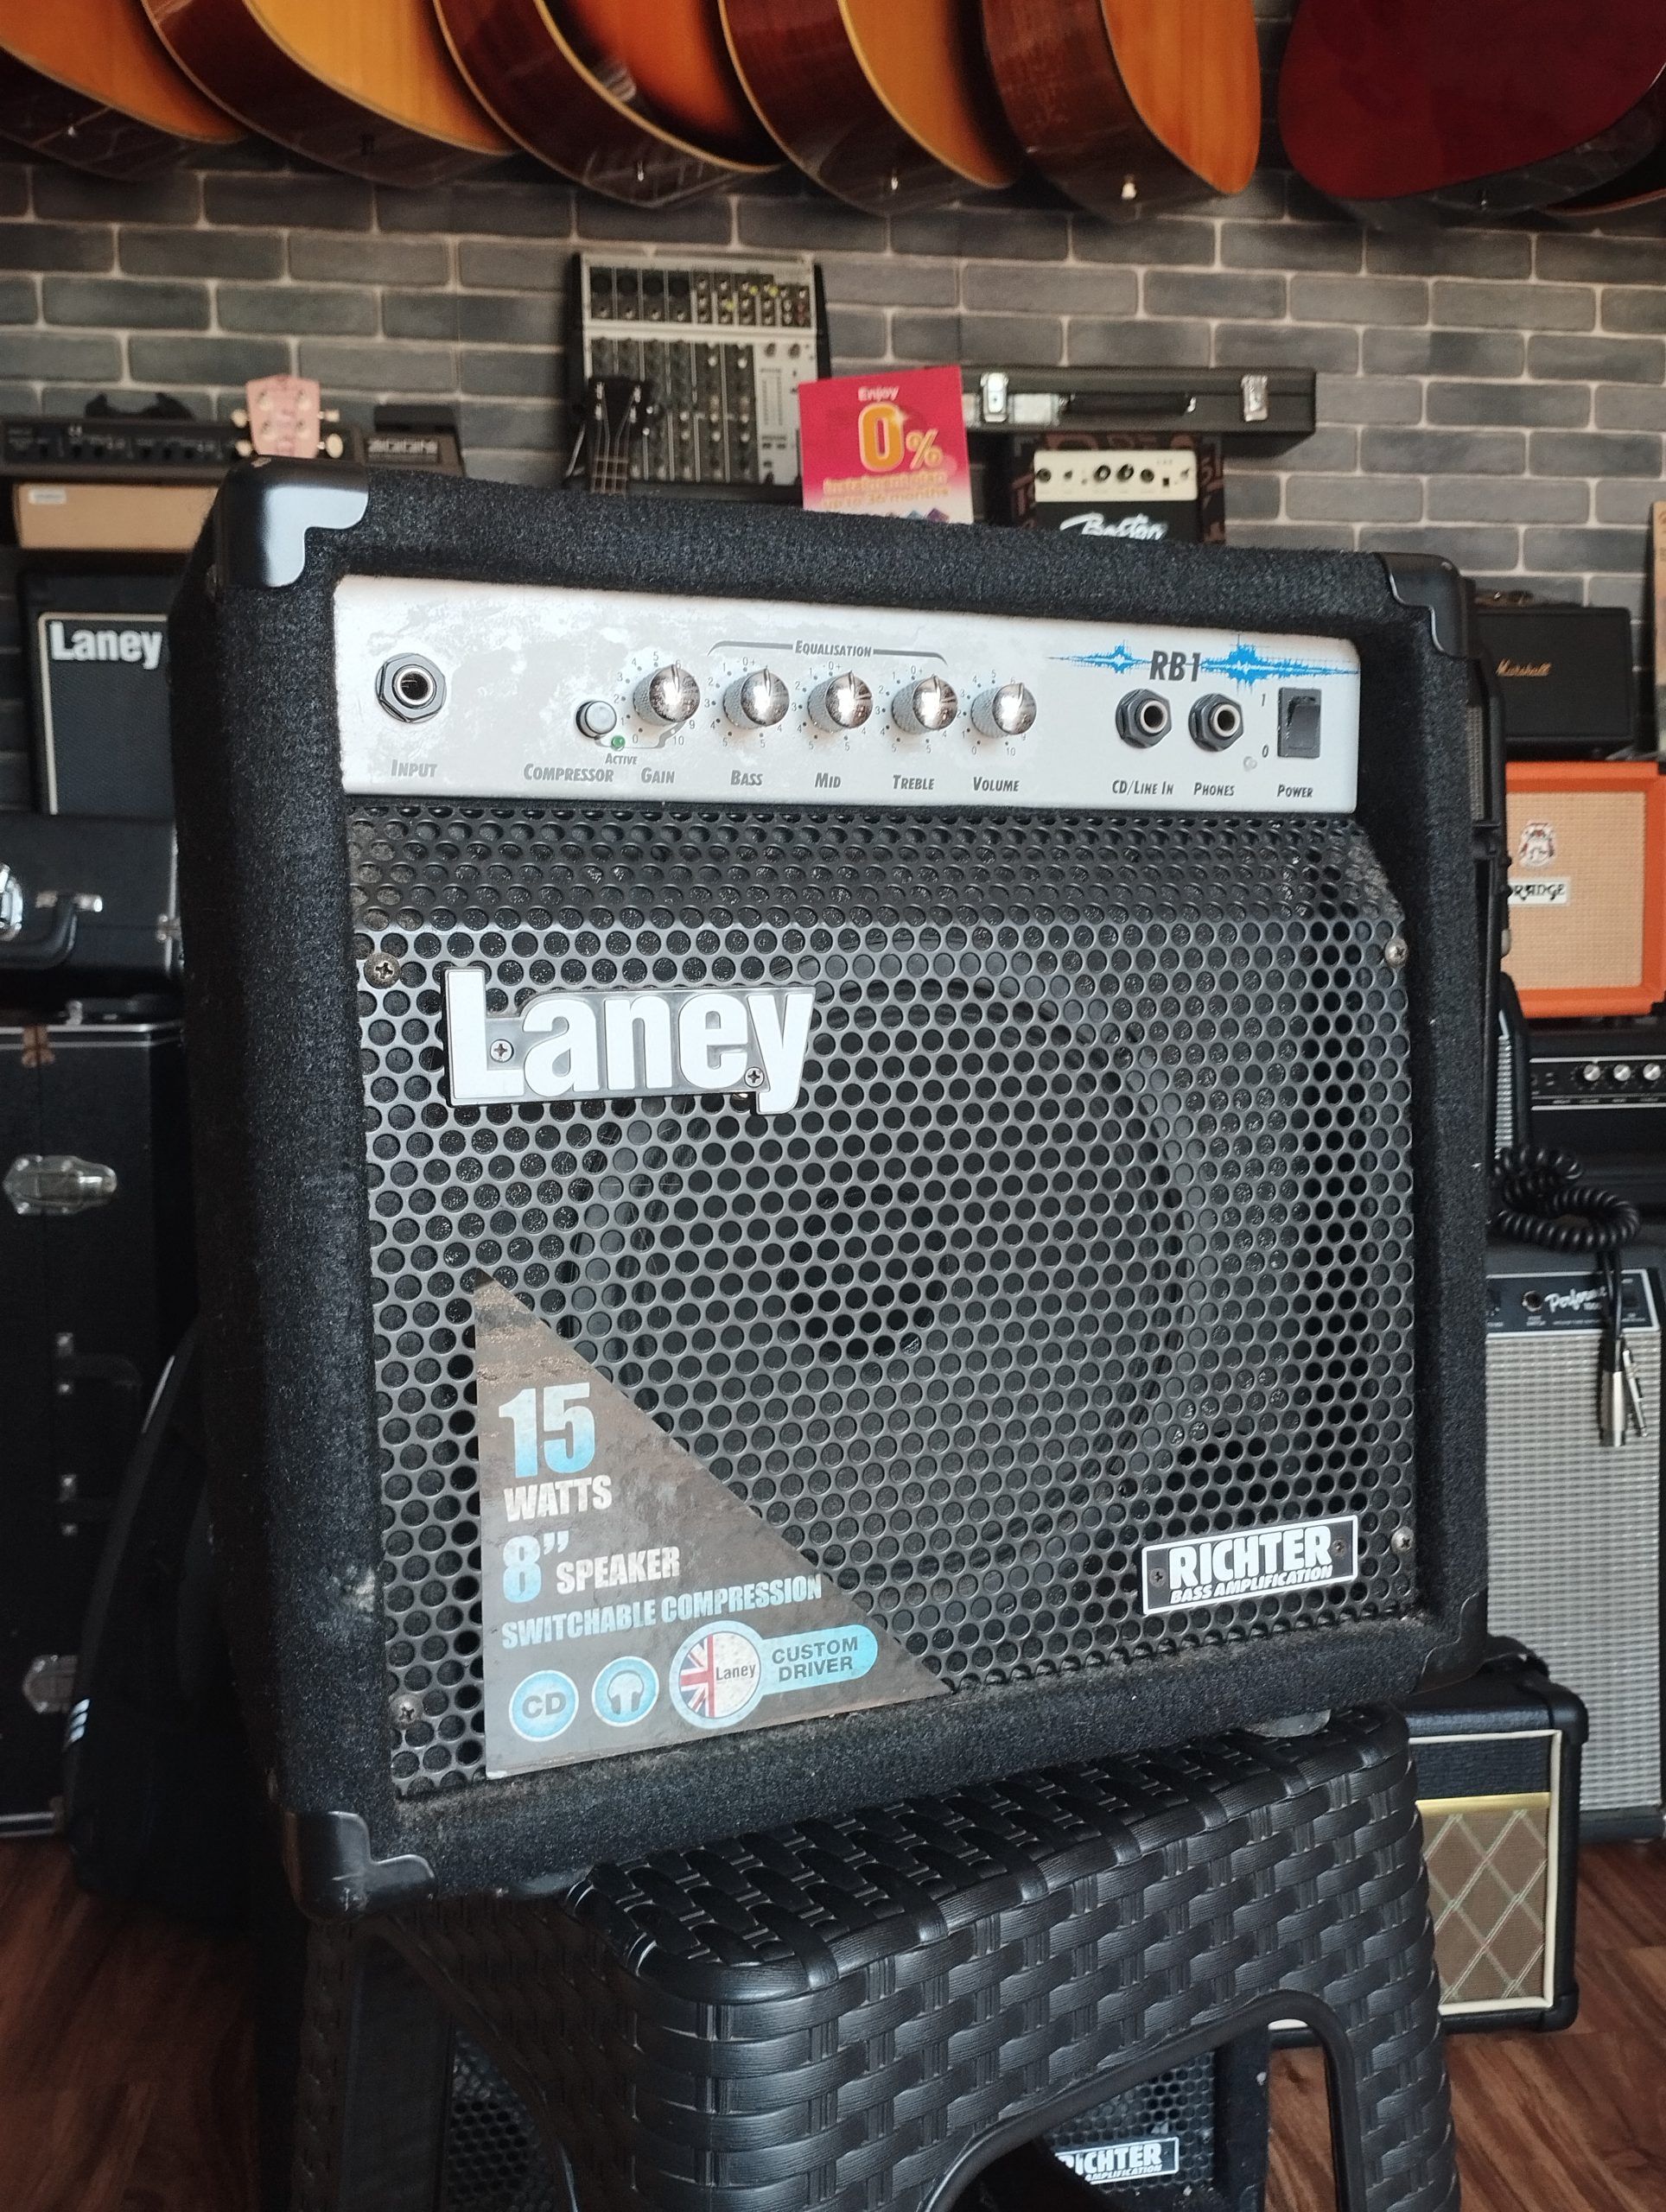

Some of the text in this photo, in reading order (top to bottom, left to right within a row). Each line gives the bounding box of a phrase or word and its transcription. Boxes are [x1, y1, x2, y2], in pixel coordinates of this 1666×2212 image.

[858, 385, 900, 402] Enjoy
[858, 401, 944, 472] 0%
[49, 622, 162, 670] Laney
[795, 639, 872, 658] EQUALISATION
[1149, 650, 1201, 682] RB1
[391, 759, 438, 778] INPUT
[523, 763, 614, 783] COMPRESSOR
[640, 766, 675, 784] GAIN
[730, 769, 763, 786] BASS
[815, 772, 842, 788] MID
[893, 774, 935, 791] TREBLE
[973, 776, 1020, 792] VOLUME
[1192, 781, 1235, 797] PHONES
[1276, 784, 1314, 798] POWER
[1513, 882, 1565, 901] RANGE
[447, 969, 815, 1114] Laney
[499, 1382, 595, 1478] 15
[504, 1475, 613, 1522] WATTS
[1168, 1525, 1332, 1590] RICHTER
[556, 1546, 680, 1595] SPEAKER
[1169, 1564, 1333, 1605] BASS AMPLIFICATION
[501, 1573, 822, 1649] SWITCHABLE COMPRESSION
[772, 1636, 859, 1665] CUSTOM
[715, 1663, 757, 1681] Laney
[779, 1656, 853, 1682] DRIVER
[522, 1692, 567, 1719] CD
